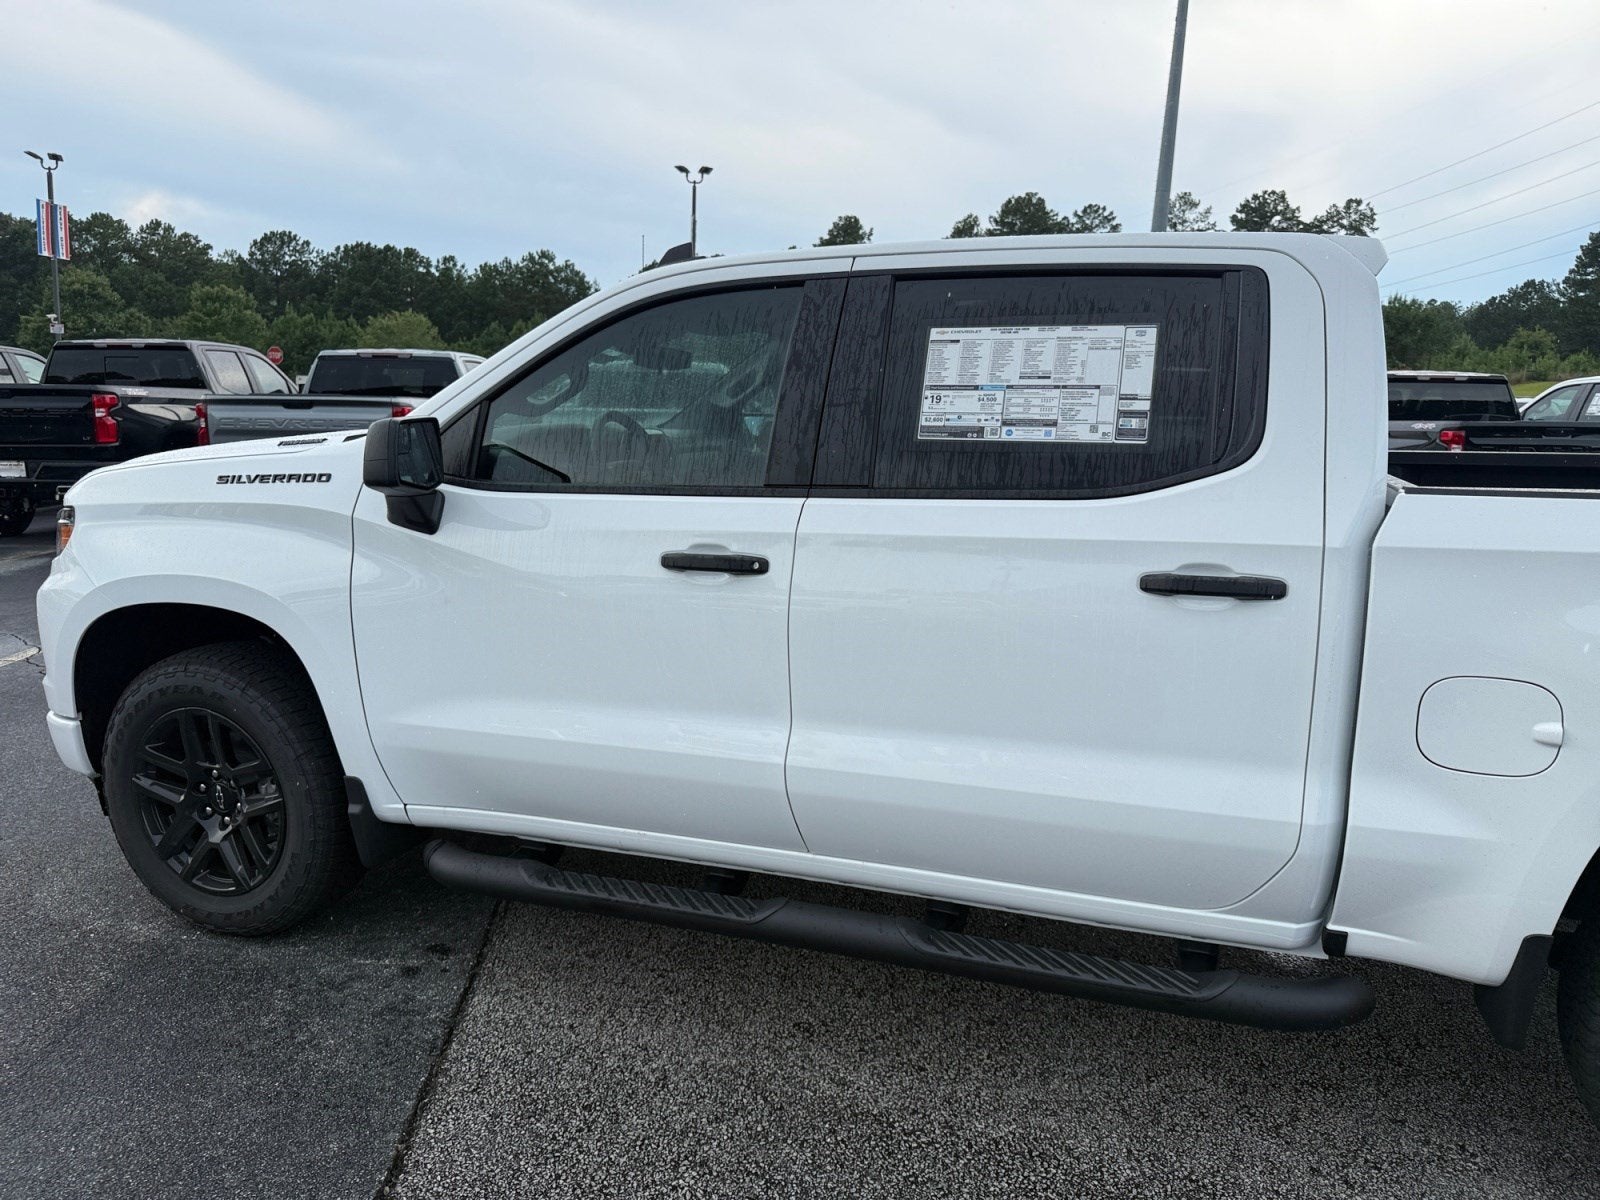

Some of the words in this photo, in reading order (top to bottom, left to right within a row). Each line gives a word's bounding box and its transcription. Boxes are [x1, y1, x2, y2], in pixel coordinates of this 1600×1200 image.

[268, 351, 282, 359] STOP
[930, 395, 942, 404] 19
[219, 417, 371, 430] CHEVROLE
[216, 473, 332, 485] SILVERADO
